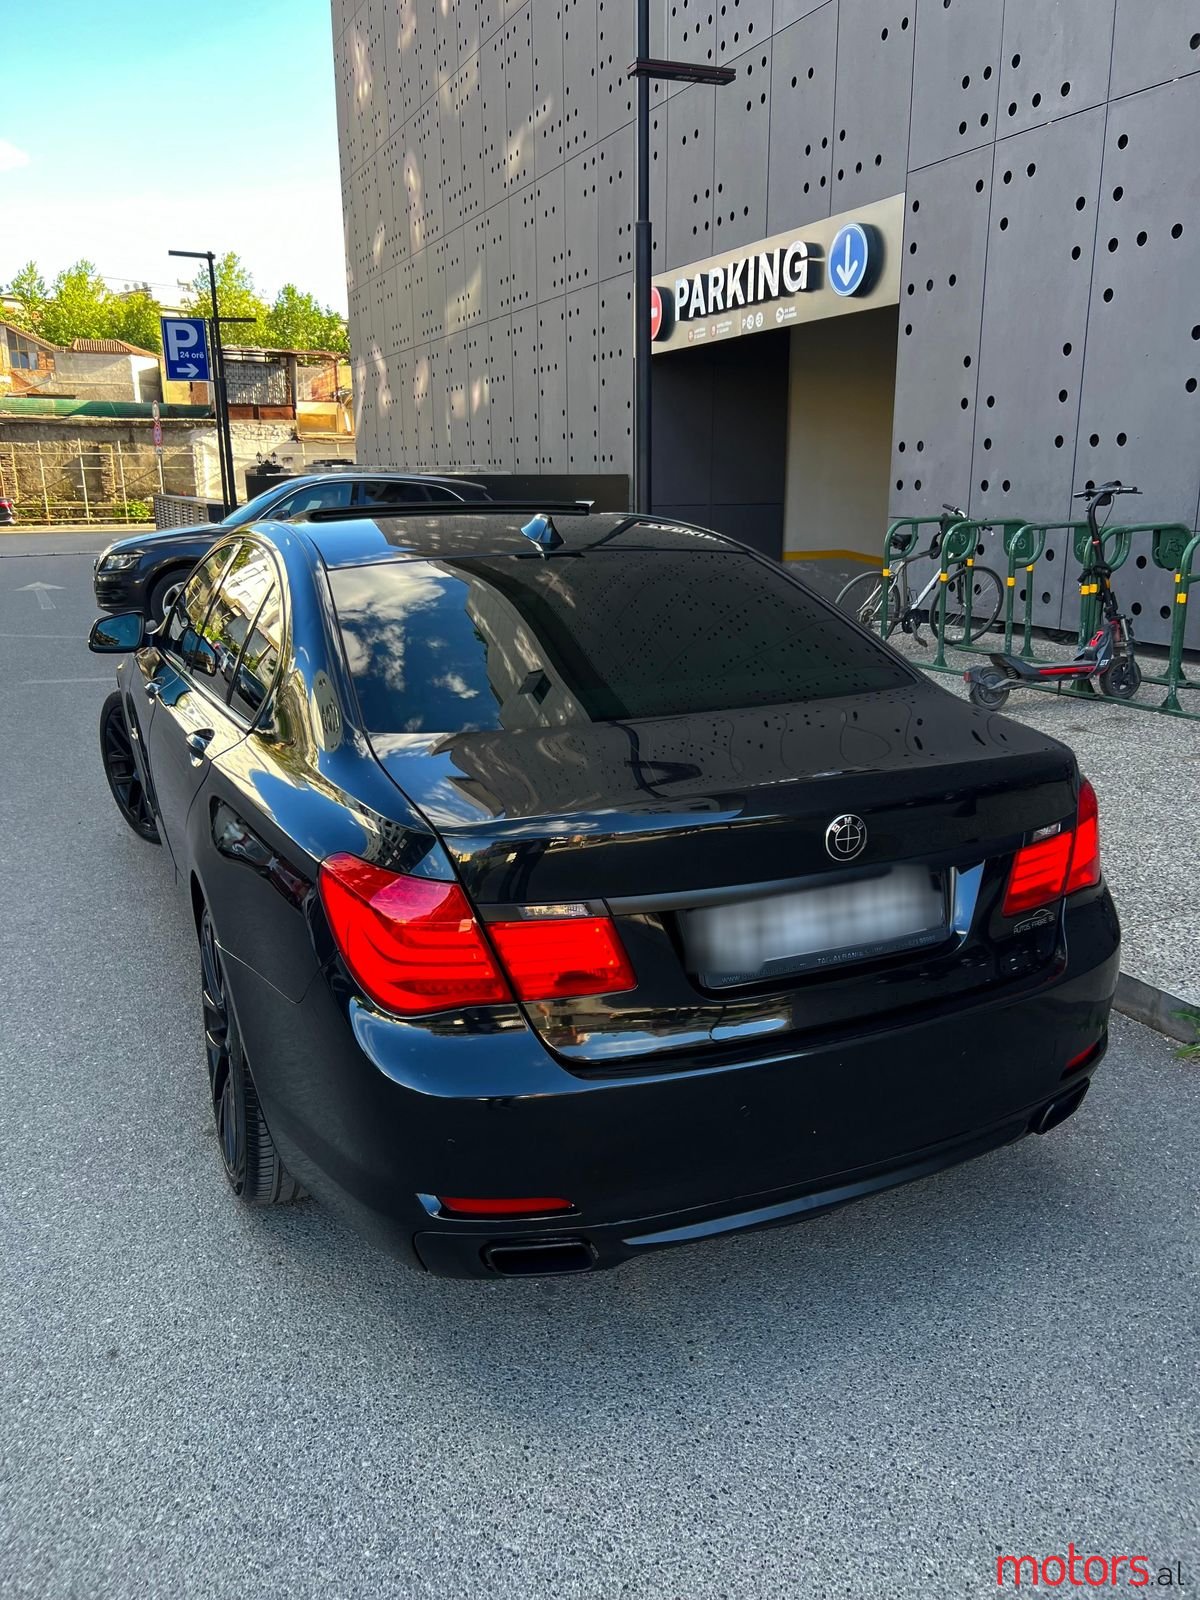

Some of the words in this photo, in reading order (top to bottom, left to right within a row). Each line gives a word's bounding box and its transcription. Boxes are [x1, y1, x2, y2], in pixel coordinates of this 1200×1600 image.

[674, 240, 809, 322] PARKING
[166, 321, 199, 361] P
[180, 351, 190, 359] 24
[191, 351, 205, 359] orë
